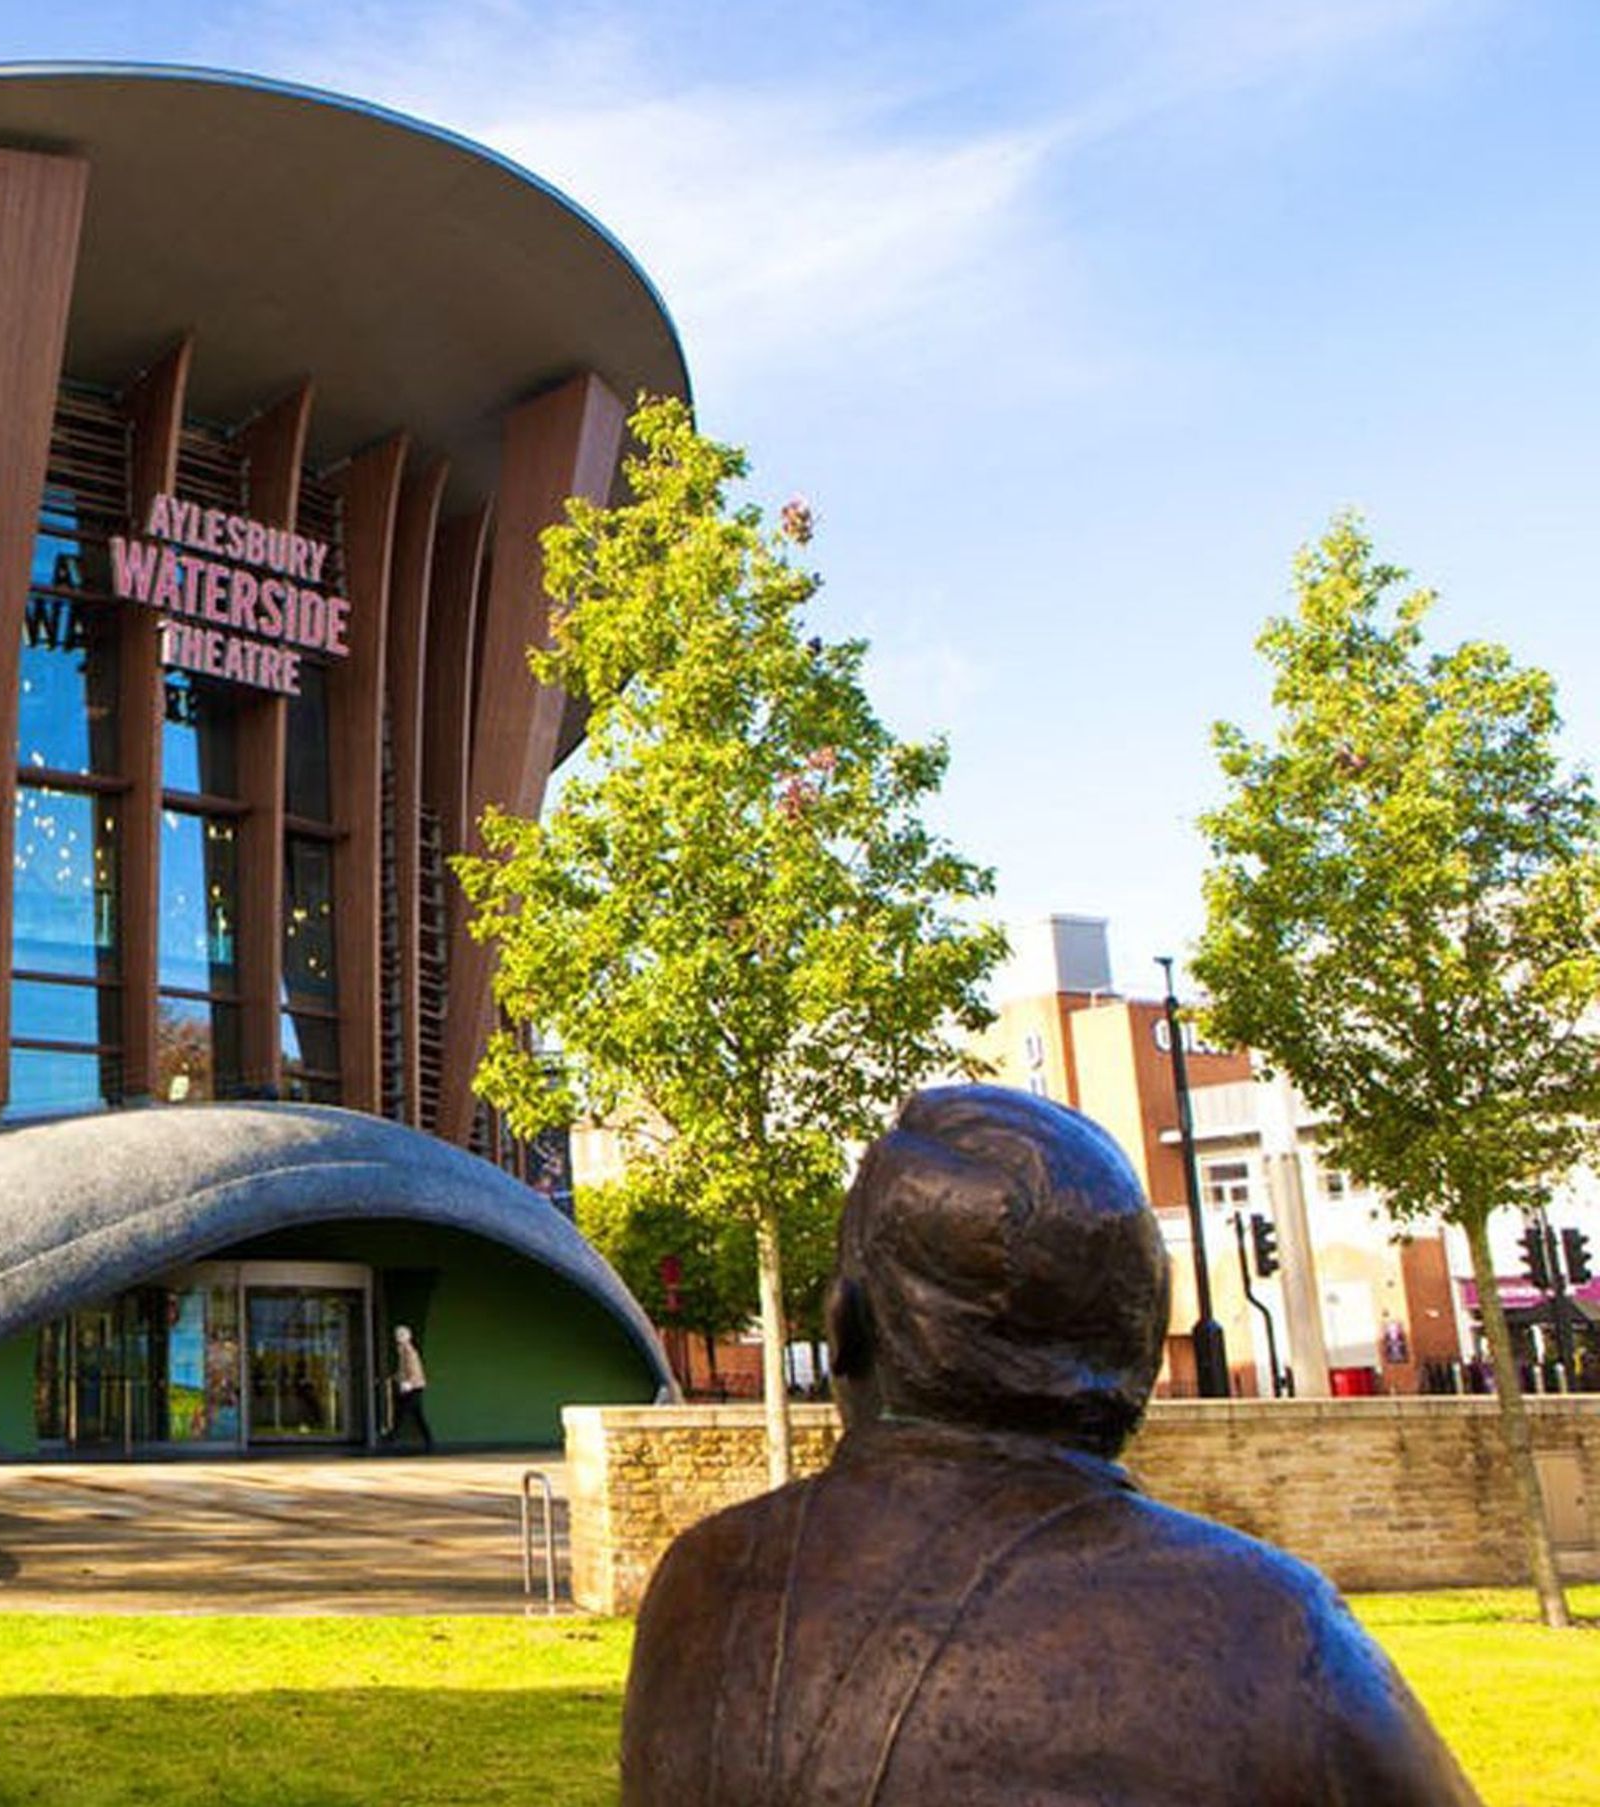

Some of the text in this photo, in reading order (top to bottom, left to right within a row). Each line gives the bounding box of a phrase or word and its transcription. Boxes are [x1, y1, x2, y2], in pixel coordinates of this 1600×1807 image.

[146, 493, 328, 583] AYLESBURY
[109, 536, 351, 656] WATERSIDE
[157, 619, 301, 695] THEATRE
